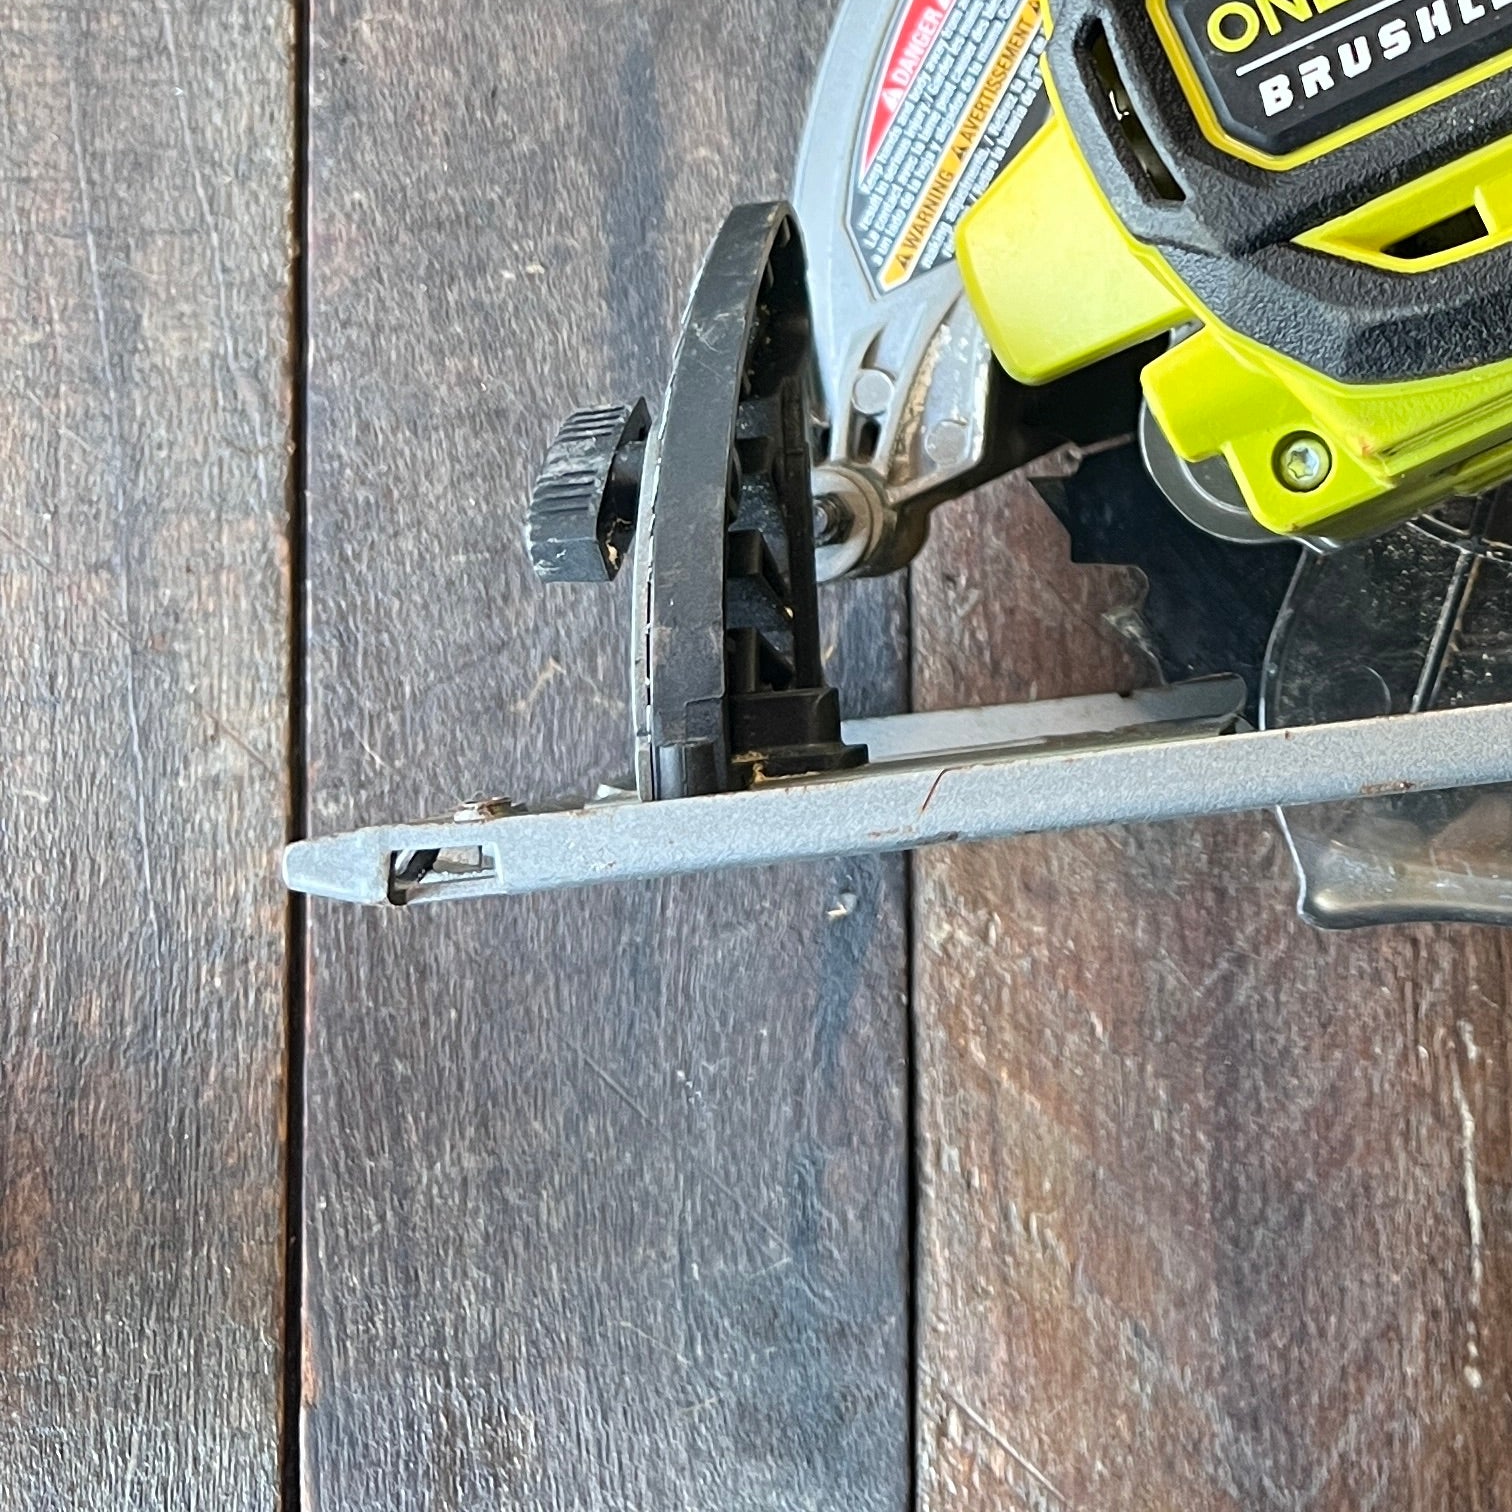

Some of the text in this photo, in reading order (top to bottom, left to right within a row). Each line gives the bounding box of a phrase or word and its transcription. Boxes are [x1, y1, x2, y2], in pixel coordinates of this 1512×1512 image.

[889, 6, 945, 87] DANGER
[874, 123, 904, 164] hands
[894, 99, 916, 127] and
[907, 70, 933, 103] body
[902, 17, 1033, 251] WARNING AVERTISSEMENT
